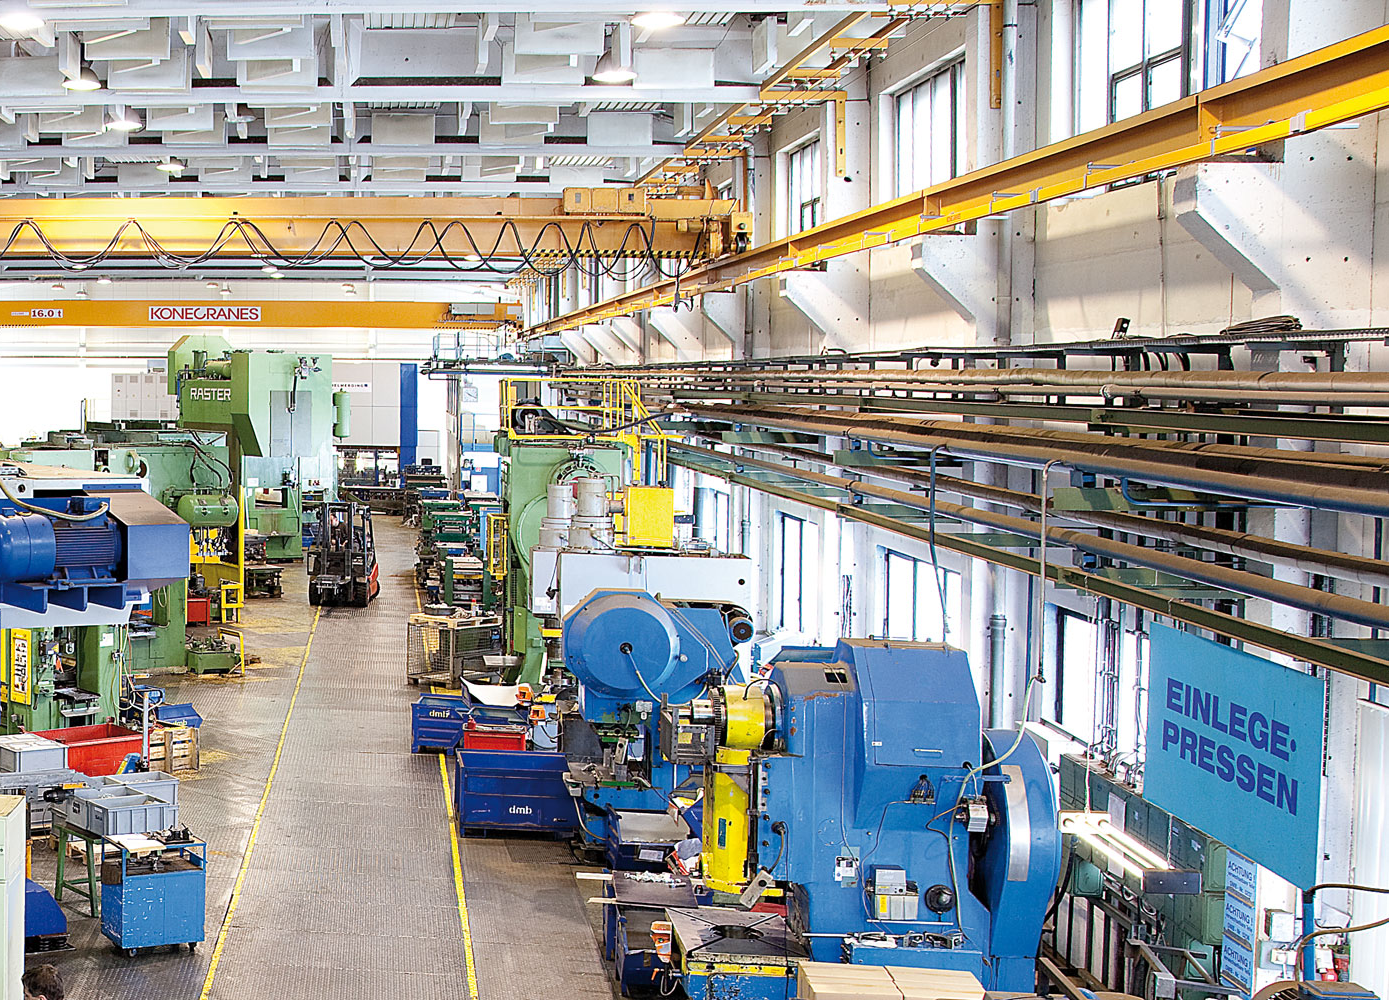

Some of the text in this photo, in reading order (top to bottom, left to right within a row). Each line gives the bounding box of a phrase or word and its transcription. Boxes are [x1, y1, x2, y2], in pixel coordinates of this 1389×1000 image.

[31, 309, 55, 318] 16.0
[57, 309, 62, 318] t
[150, 307, 260, 320] KONECRANES
[190, 387, 232, 401] RASTER
[1162, 719, 1299, 817] PRESSEN
[508, 804, 533, 815] dmb
